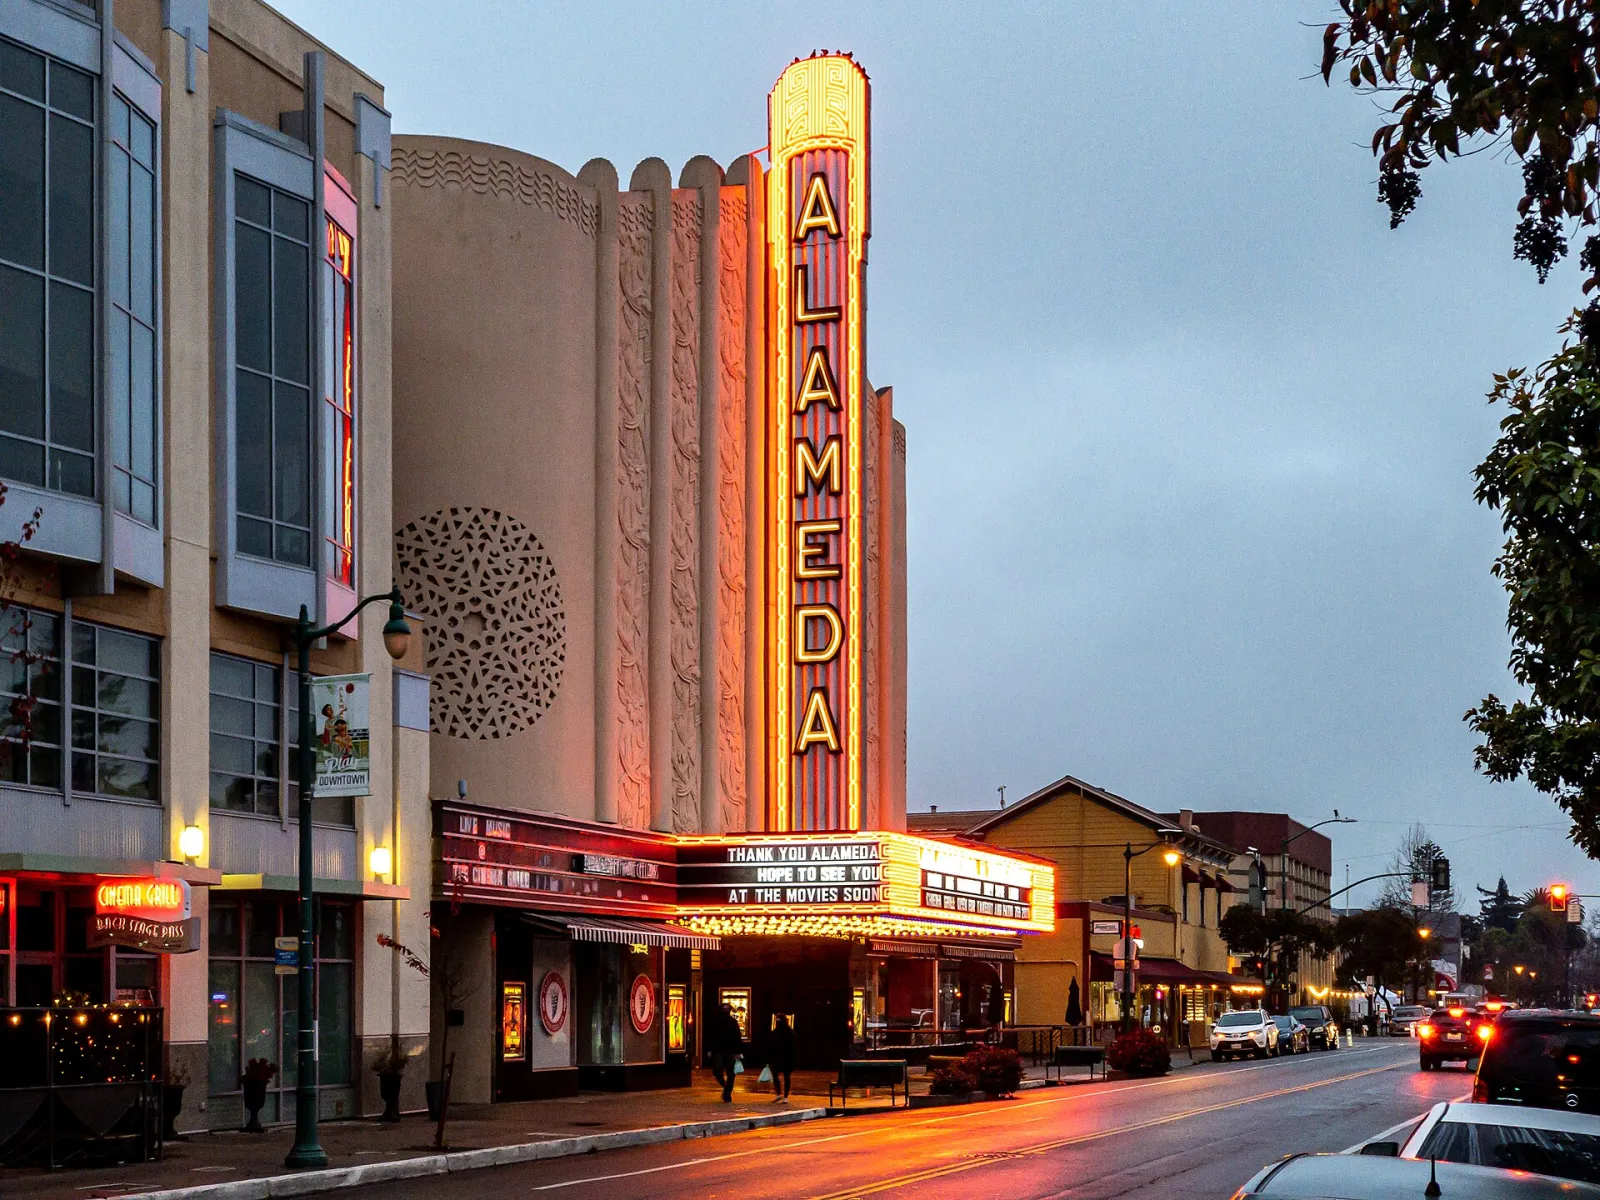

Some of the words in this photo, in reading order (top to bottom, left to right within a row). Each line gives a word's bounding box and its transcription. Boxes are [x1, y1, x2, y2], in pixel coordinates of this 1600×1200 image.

[793, 171, 844, 755] ALAMEDA
[319, 774, 365, 786] DOWNTOWN
[460, 815, 477, 835] LIVE
[486, 820, 511, 839] MUSIC
[727, 846, 774, 862] THANK
[779, 846, 807, 862] YOU
[811, 845, 879, 861] ALAMEDA
[757, 867, 794, 882] HOPE
[798, 867, 817, 882] TO
[820, 867, 846, 881] SEE
[852, 866, 880, 881] YOU
[98, 885, 142, 907] CINEMA
[146, 884, 180, 906] GRILL
[728, 889, 748, 903] AT
[755, 888, 781, 902] THE
[786, 887, 838, 902] MOVIES
[843, 887, 880, 902] SOON
[96, 917, 126, 931] BACK
[129, 919, 159, 938] STAGE
[161, 925, 184, 938] PASS
